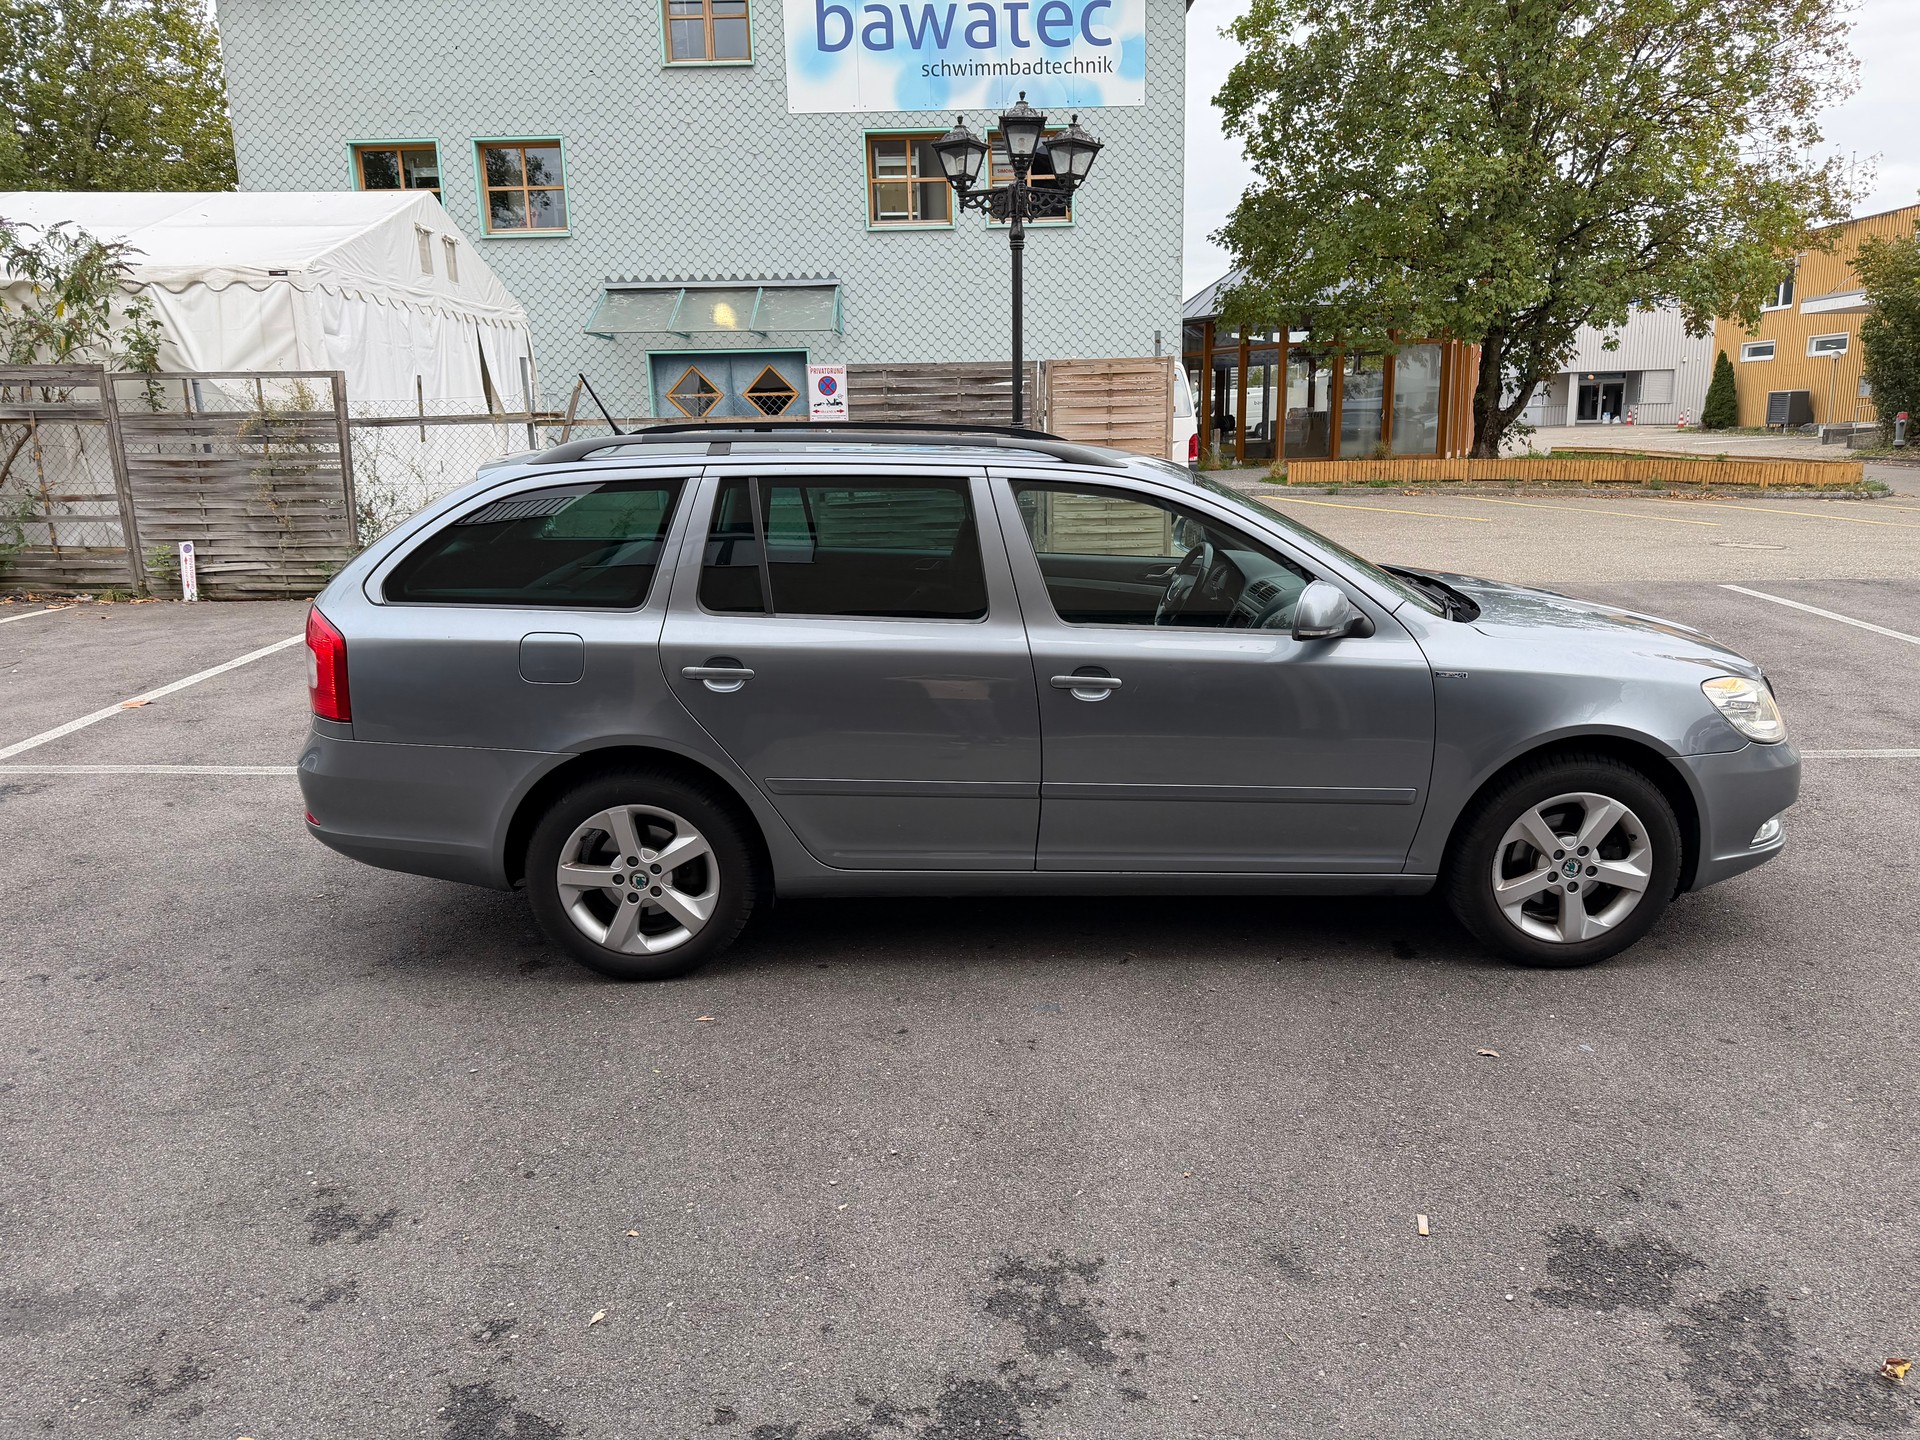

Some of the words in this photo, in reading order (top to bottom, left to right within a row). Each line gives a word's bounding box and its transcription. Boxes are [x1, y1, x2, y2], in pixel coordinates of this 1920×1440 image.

[815, 0, 1113, 52] bawatec
[921, 56, 1113, 77] schwimmbadtechnik
[810, 367, 844, 375] PRIVATGRUND
